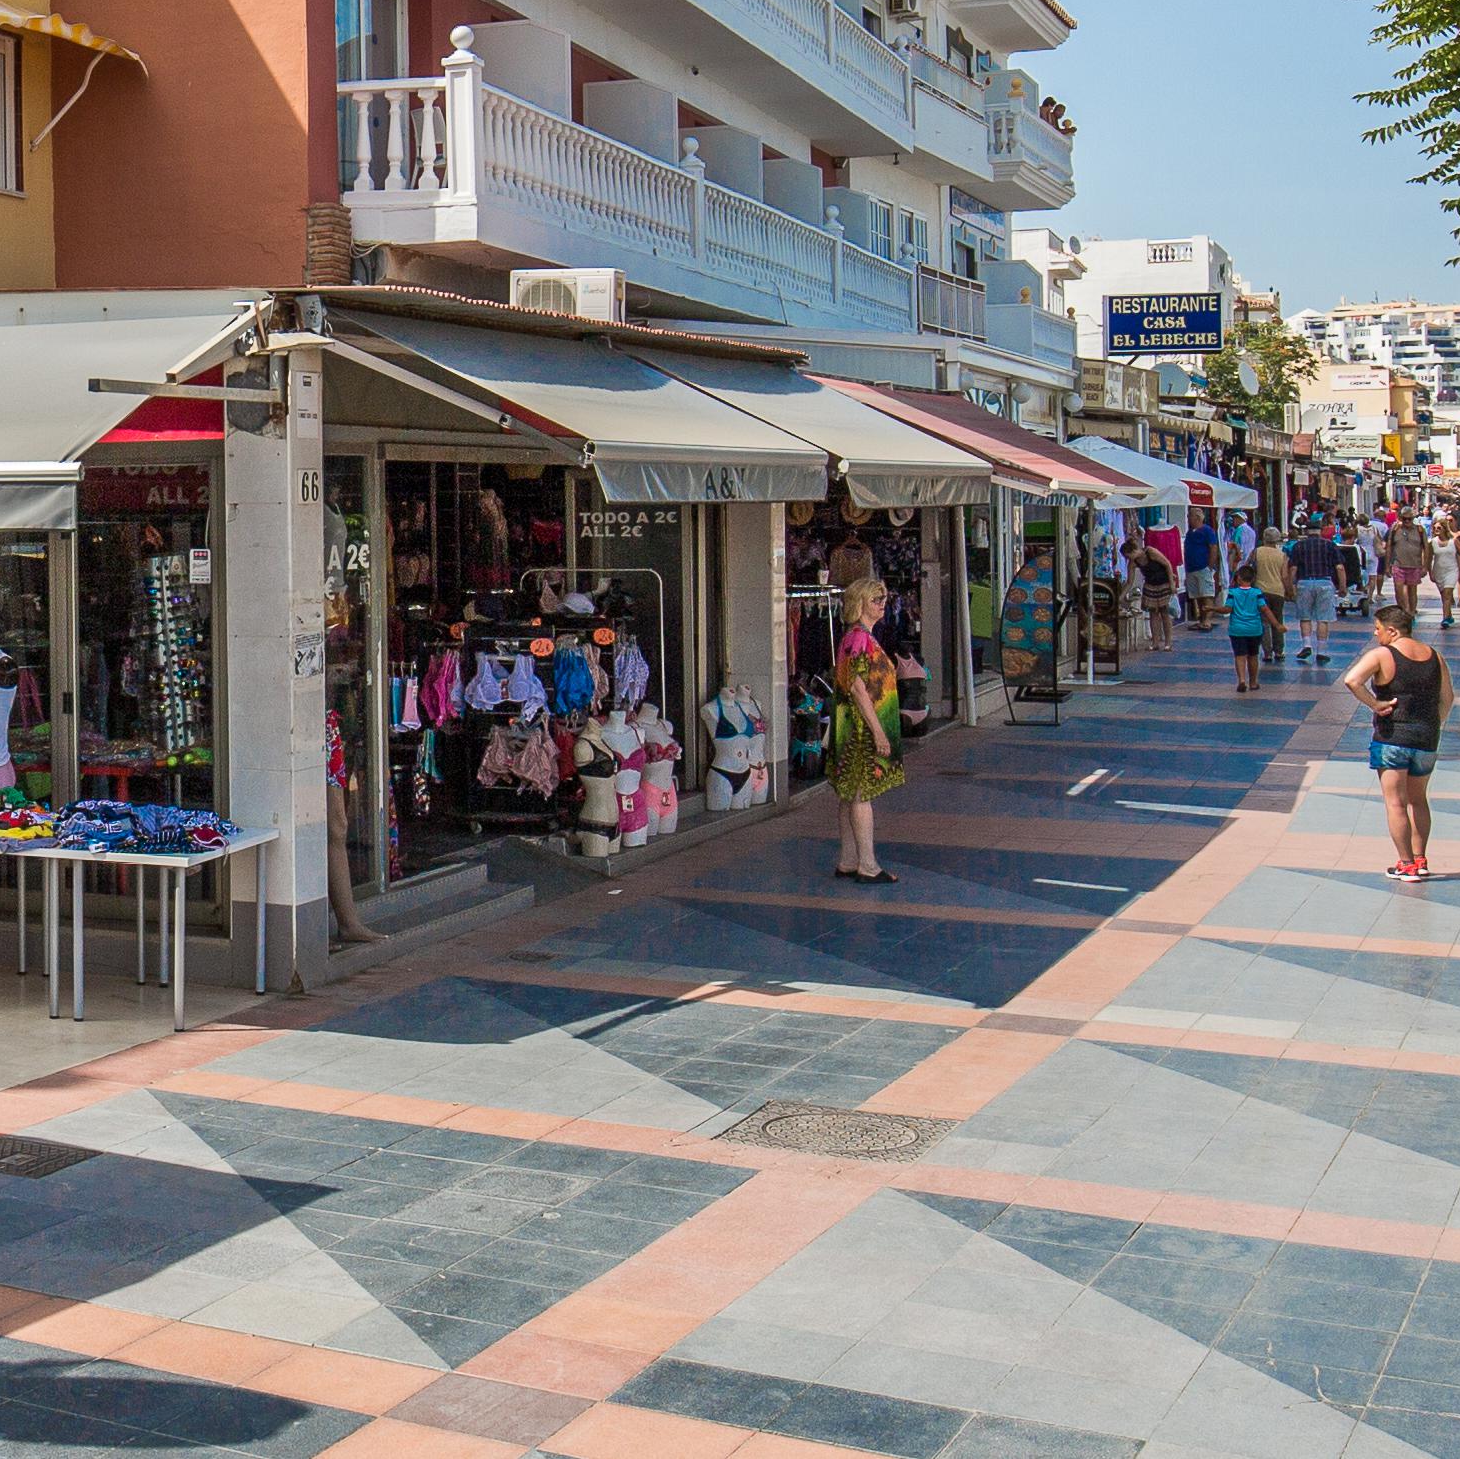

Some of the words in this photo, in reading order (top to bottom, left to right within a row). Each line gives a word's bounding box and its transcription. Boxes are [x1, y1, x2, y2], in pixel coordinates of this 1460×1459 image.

[1112, 296, 1218, 314] RESTAURANTE
[1143, 316, 1186, 329] CASA
[1113, 334, 1135, 347] EL
[1139, 332, 1218, 346] LEBECHE
[301, 471, 319, 502] 66
[579, 511, 631, 525] TODO
[636, 511, 650, 524] A
[654, 511, 679, 524] 2€
[580, 525, 616, 538] ALL
[620, 525, 643, 538] 2€
[346, 543, 370, 570] 2€
